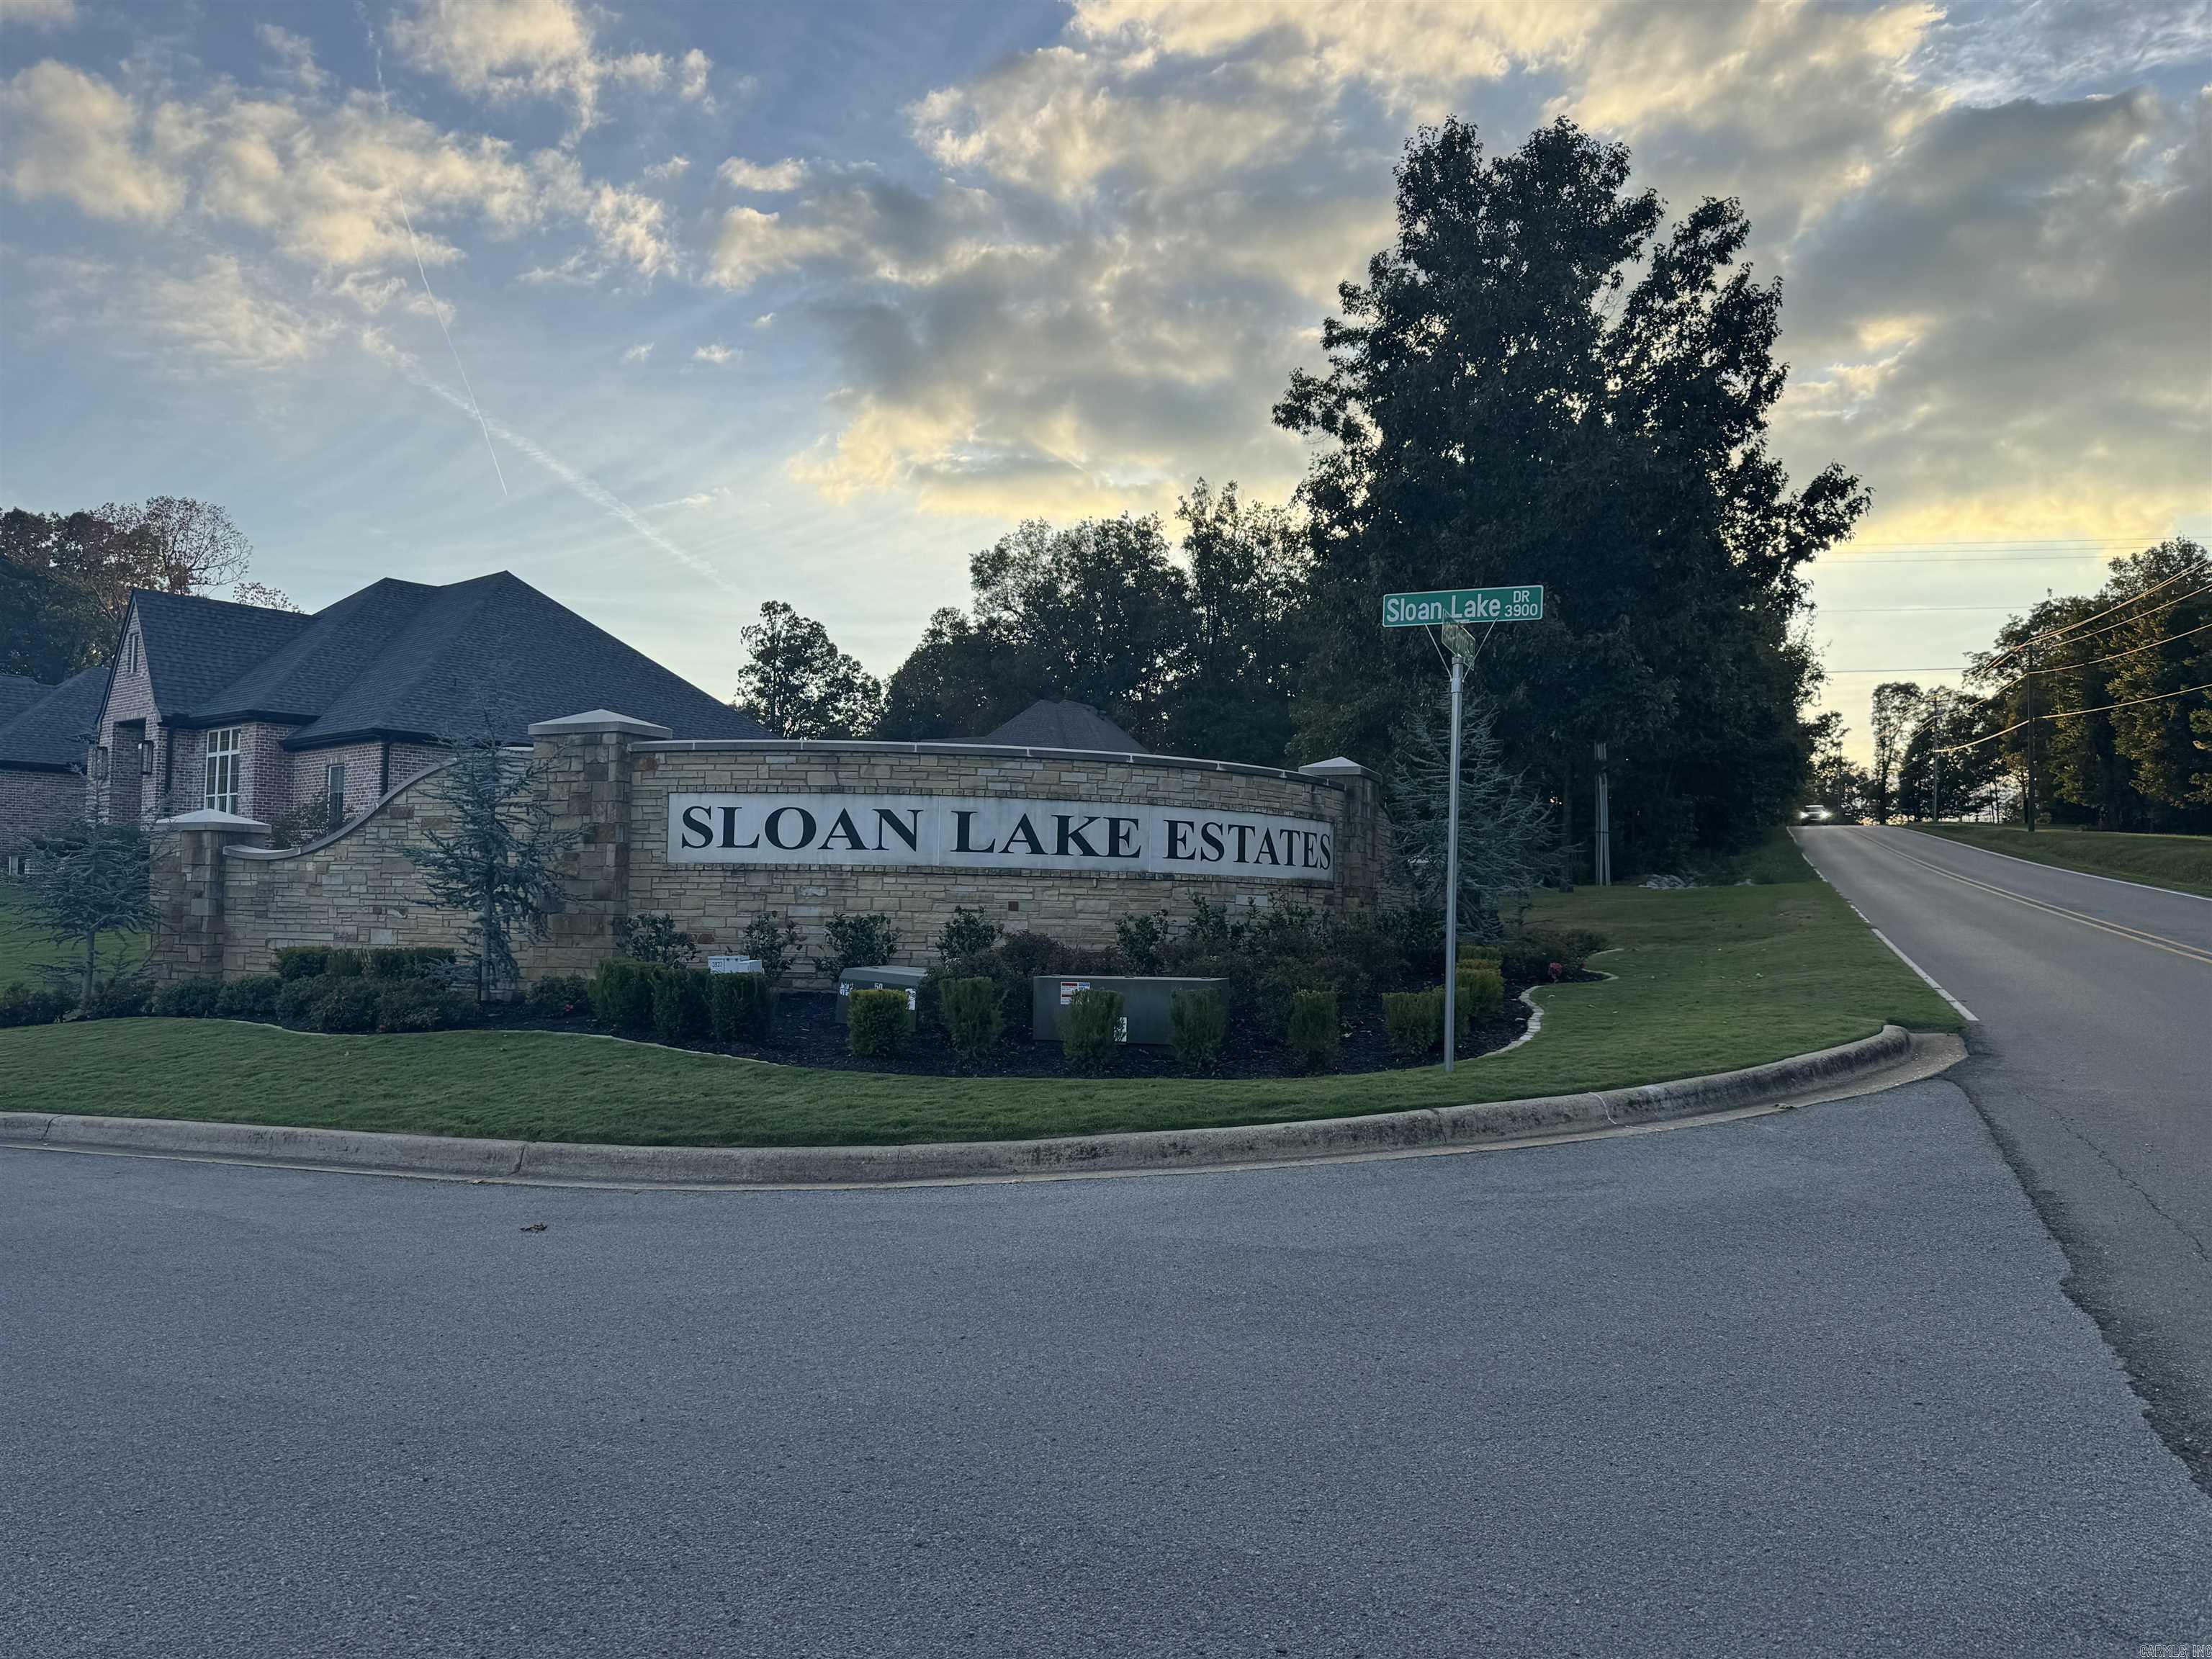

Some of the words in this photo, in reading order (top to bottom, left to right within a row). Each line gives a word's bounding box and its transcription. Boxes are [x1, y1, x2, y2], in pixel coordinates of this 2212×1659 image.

[1513, 590, 1530, 603] DR
[1386, 598, 1442, 622] Sloan
[1451, 593, 1501, 619] Lake
[1504, 603, 1538, 617] 3900
[681, 806, 925, 851] SLOAN
[950, 810, 1142, 859] LAKE
[1162, 819, 1331, 871] ESTATES
